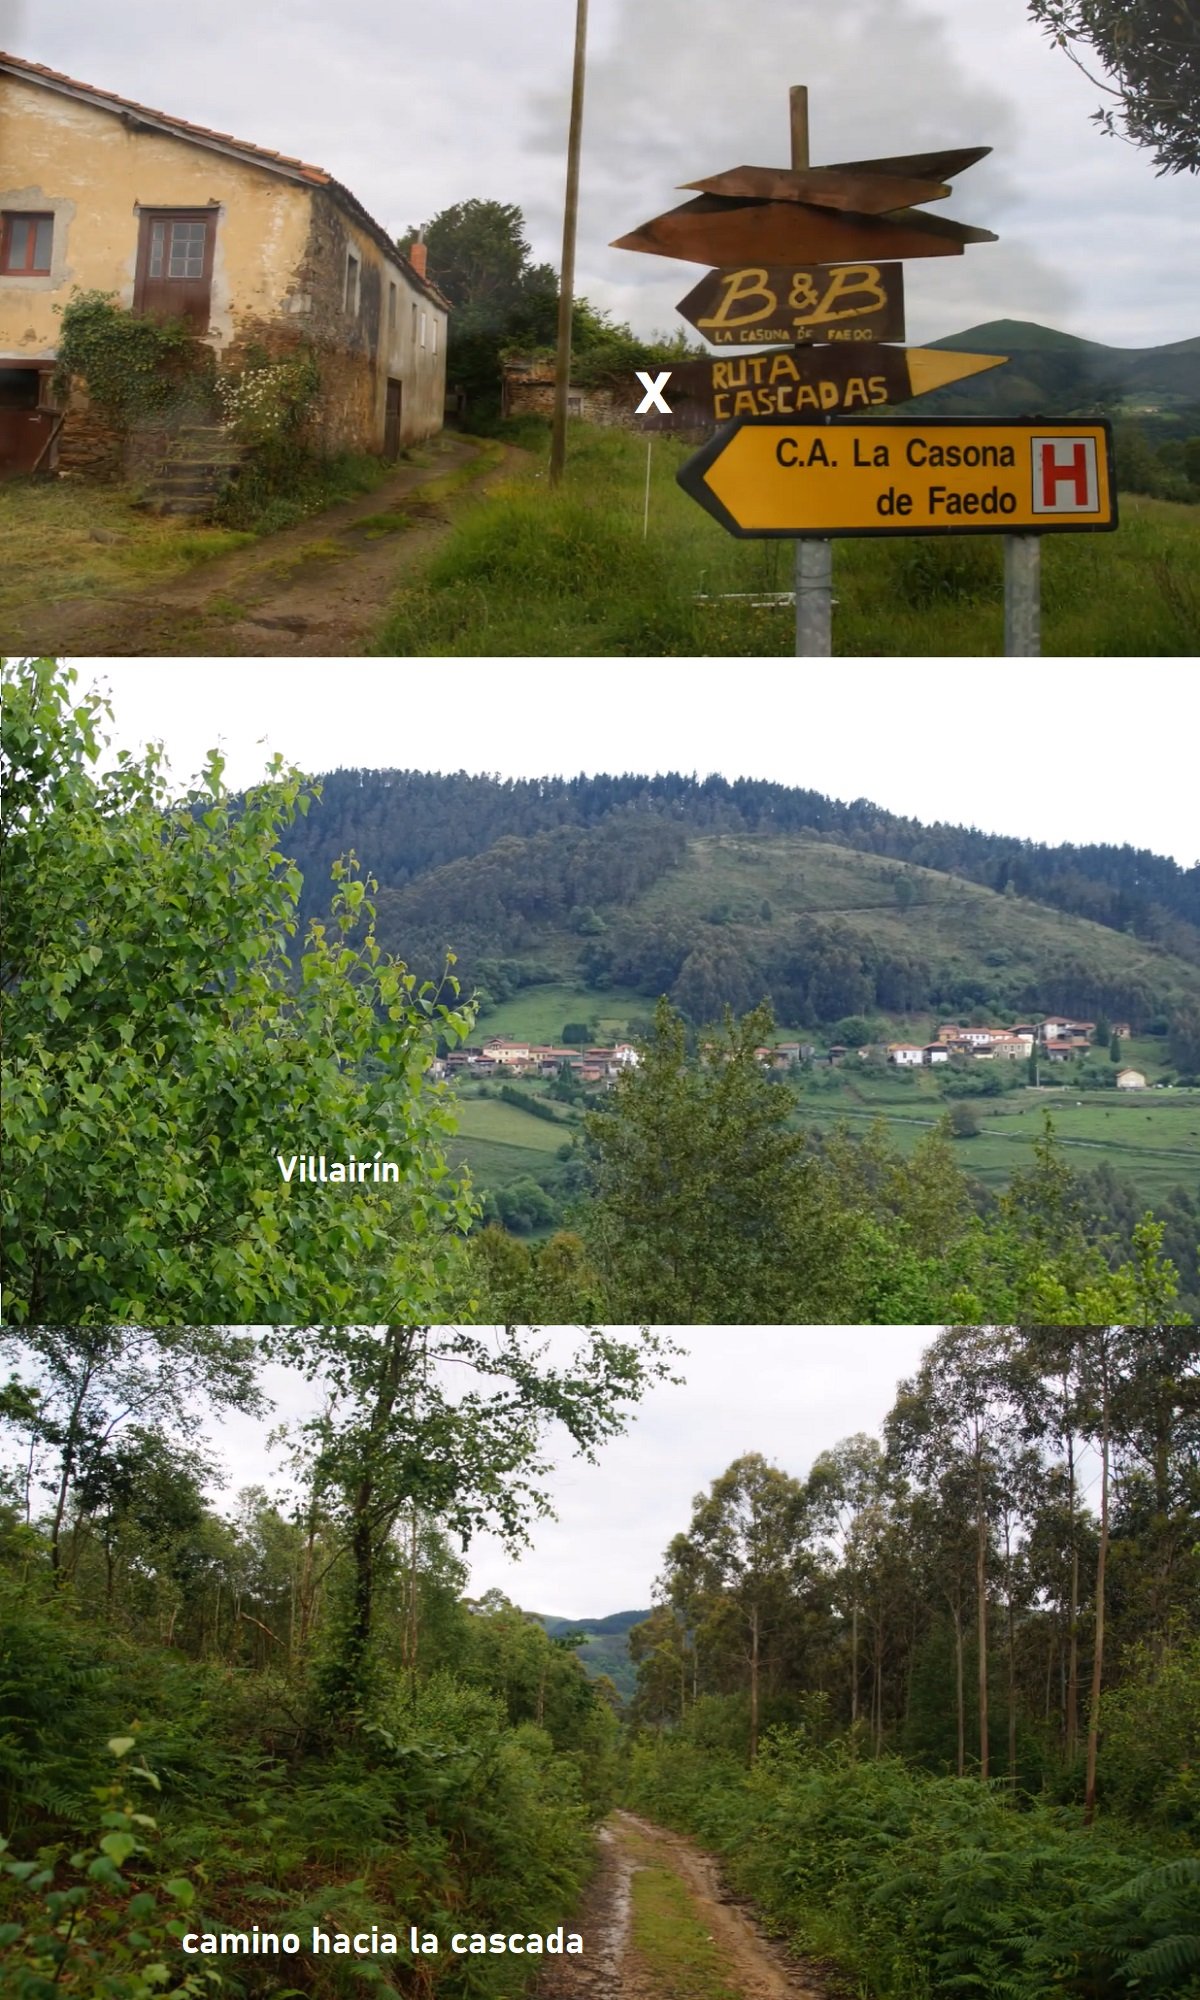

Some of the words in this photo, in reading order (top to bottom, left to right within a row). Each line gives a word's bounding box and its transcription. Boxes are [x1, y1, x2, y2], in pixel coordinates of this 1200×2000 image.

[715, 332, 733, 342] LA
[740, 328, 790, 342] CASONA
[712, 354, 801, 390] RUTA
[775, 437, 838, 468] C.A.
[854, 438, 890, 467] La
[906, 438, 1015, 467] Casona
[876, 487, 912, 516] de
[929, 486, 1017, 516] Faedo
